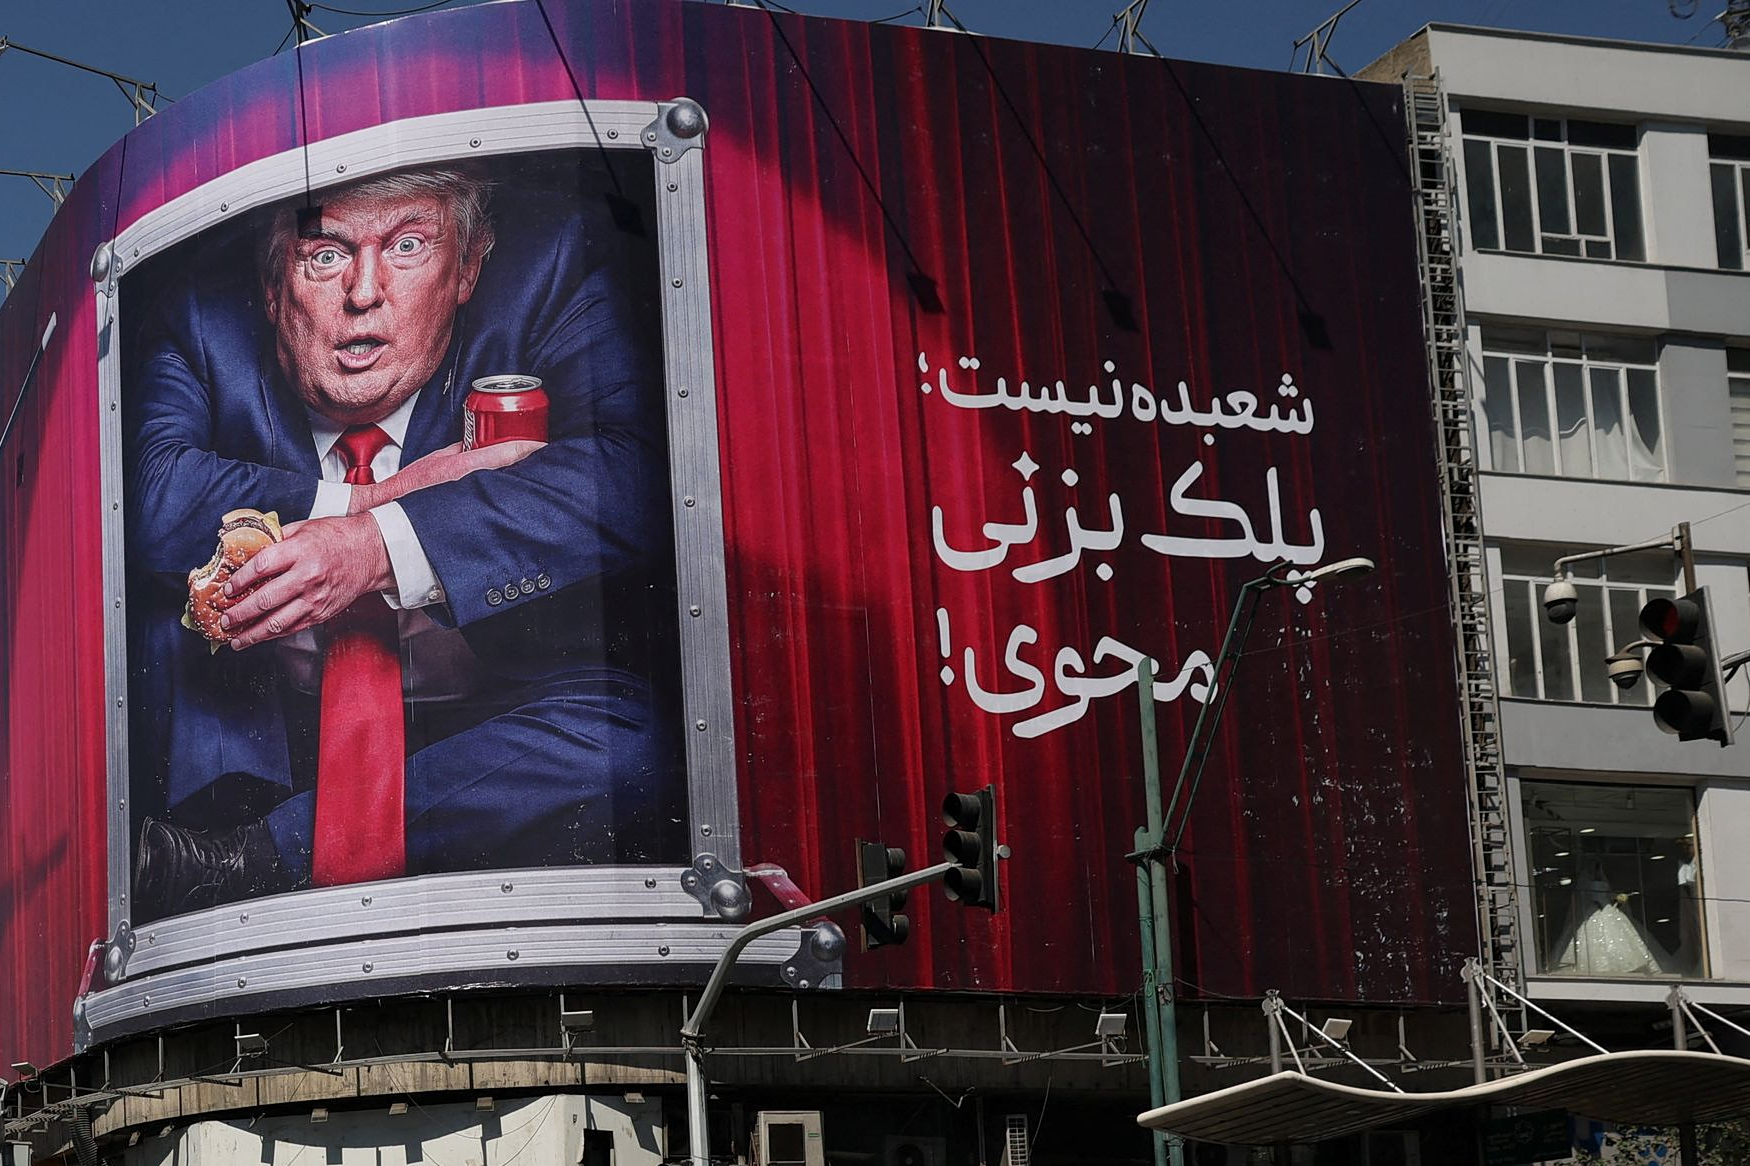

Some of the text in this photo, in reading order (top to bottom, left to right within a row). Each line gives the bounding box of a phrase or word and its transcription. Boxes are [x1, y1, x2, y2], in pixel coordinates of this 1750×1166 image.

[1131, 373, 1315, 446] شعبده
[932, 451, 1326, 605] پلک بزنی
[936, 607, 1220, 740] محوی!
